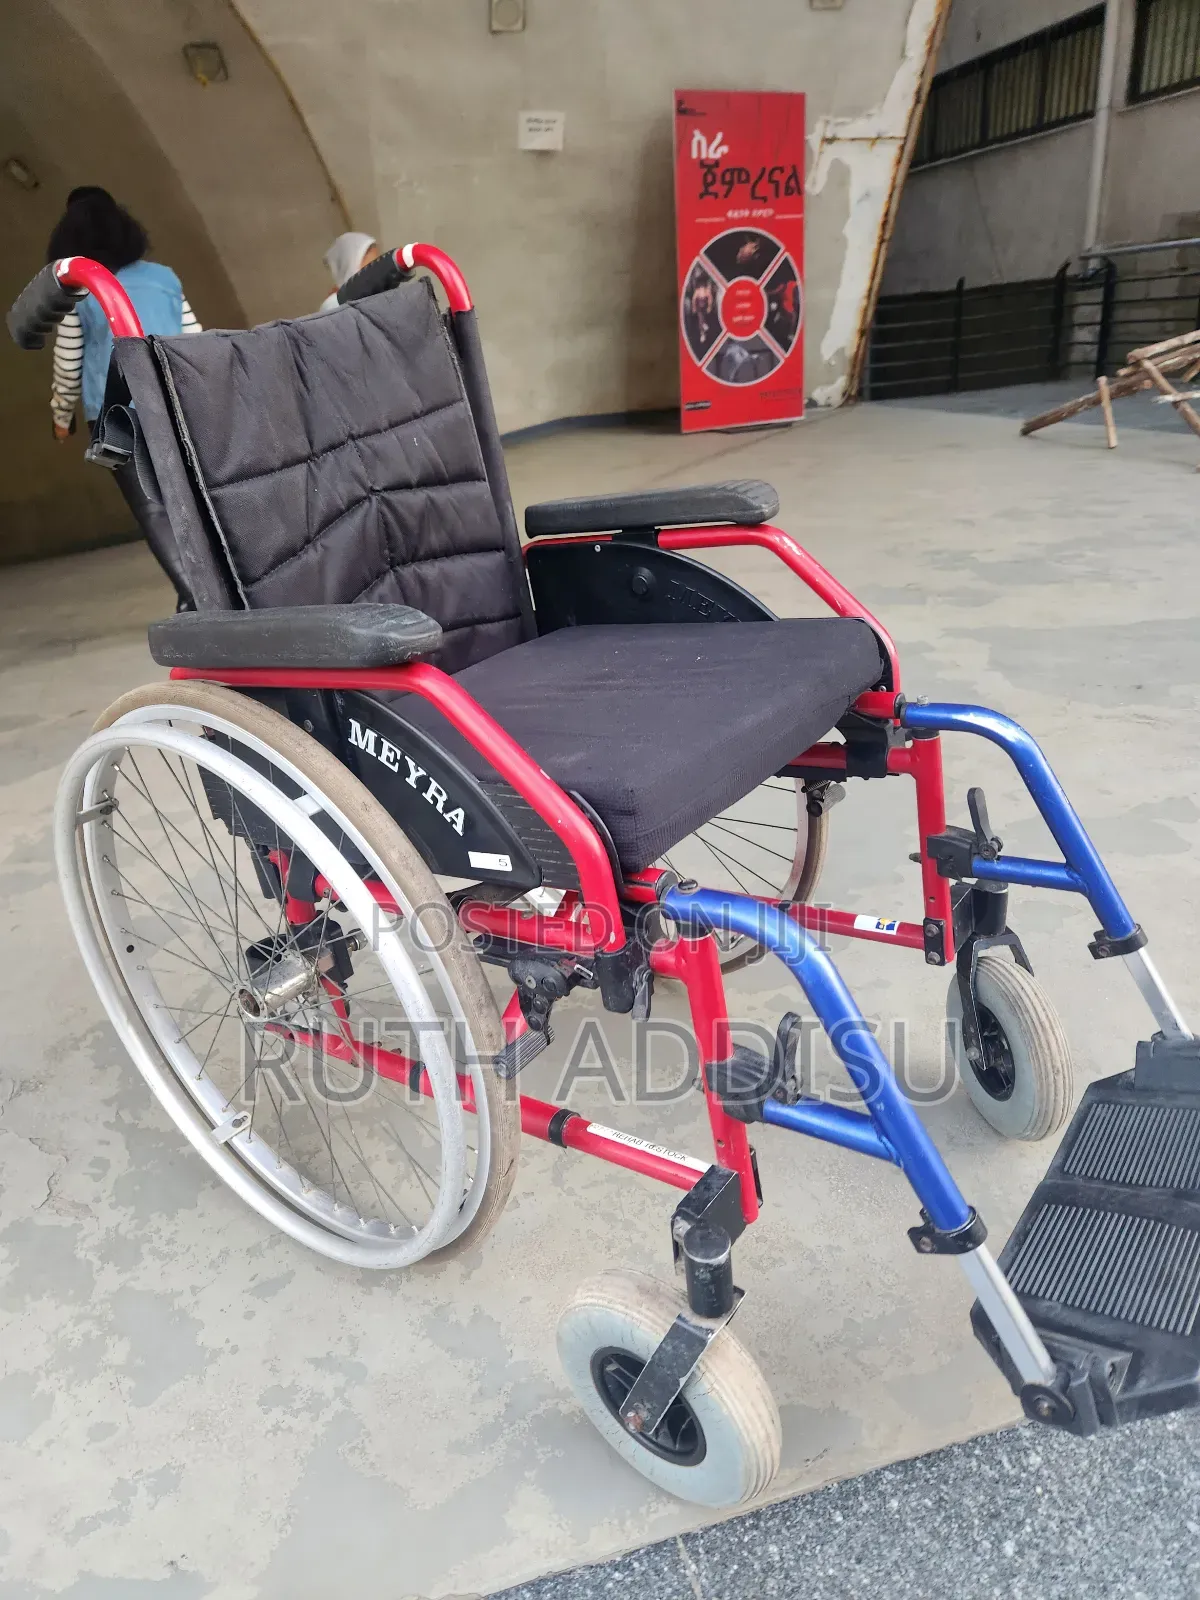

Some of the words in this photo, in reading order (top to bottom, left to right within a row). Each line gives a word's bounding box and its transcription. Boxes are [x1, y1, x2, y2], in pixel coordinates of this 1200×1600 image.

[690, 129, 729, 159] ስራ
[698, 161, 803, 203] ጀምረናል
[348, 718, 466, 837] MEYRA
[498, 858, 508, 867] 5
